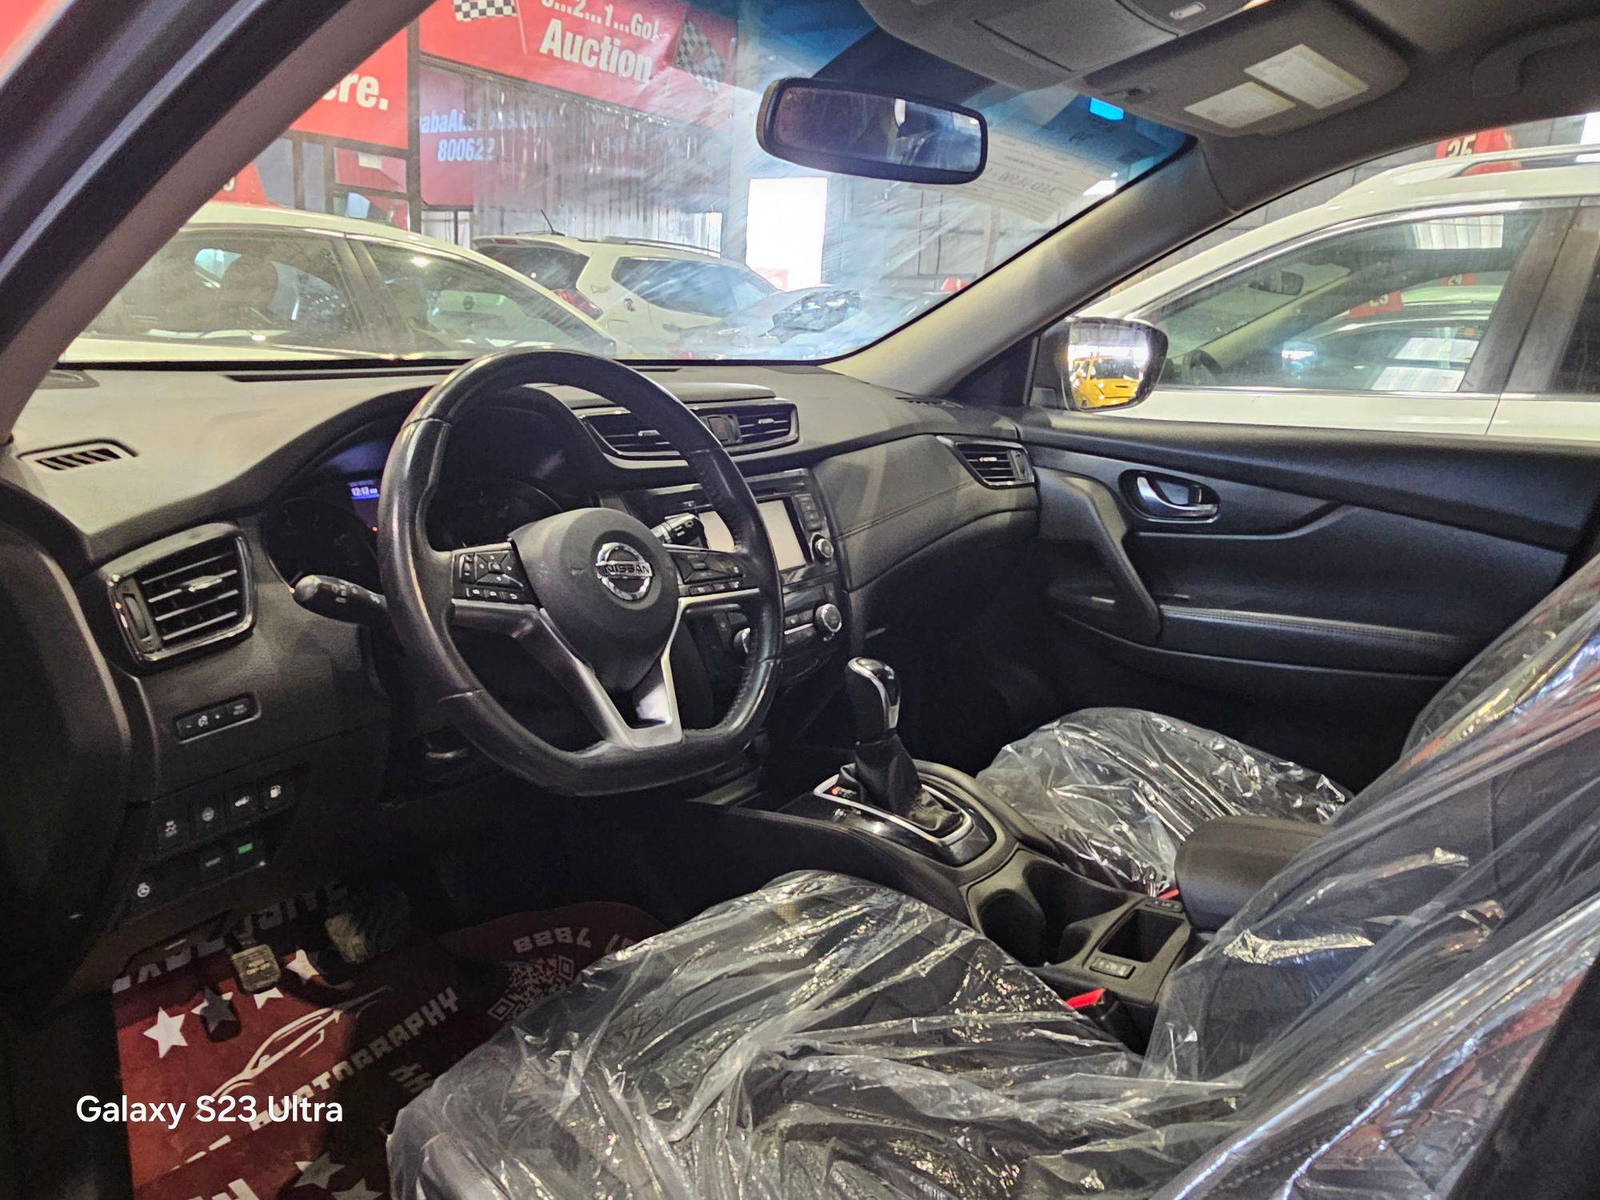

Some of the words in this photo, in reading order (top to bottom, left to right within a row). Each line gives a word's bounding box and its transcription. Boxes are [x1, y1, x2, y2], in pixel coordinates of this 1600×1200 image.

[539, 17, 653, 83] Auction
[322, 73, 390, 111] re.
[605, 562, 651, 575] NISSAN
